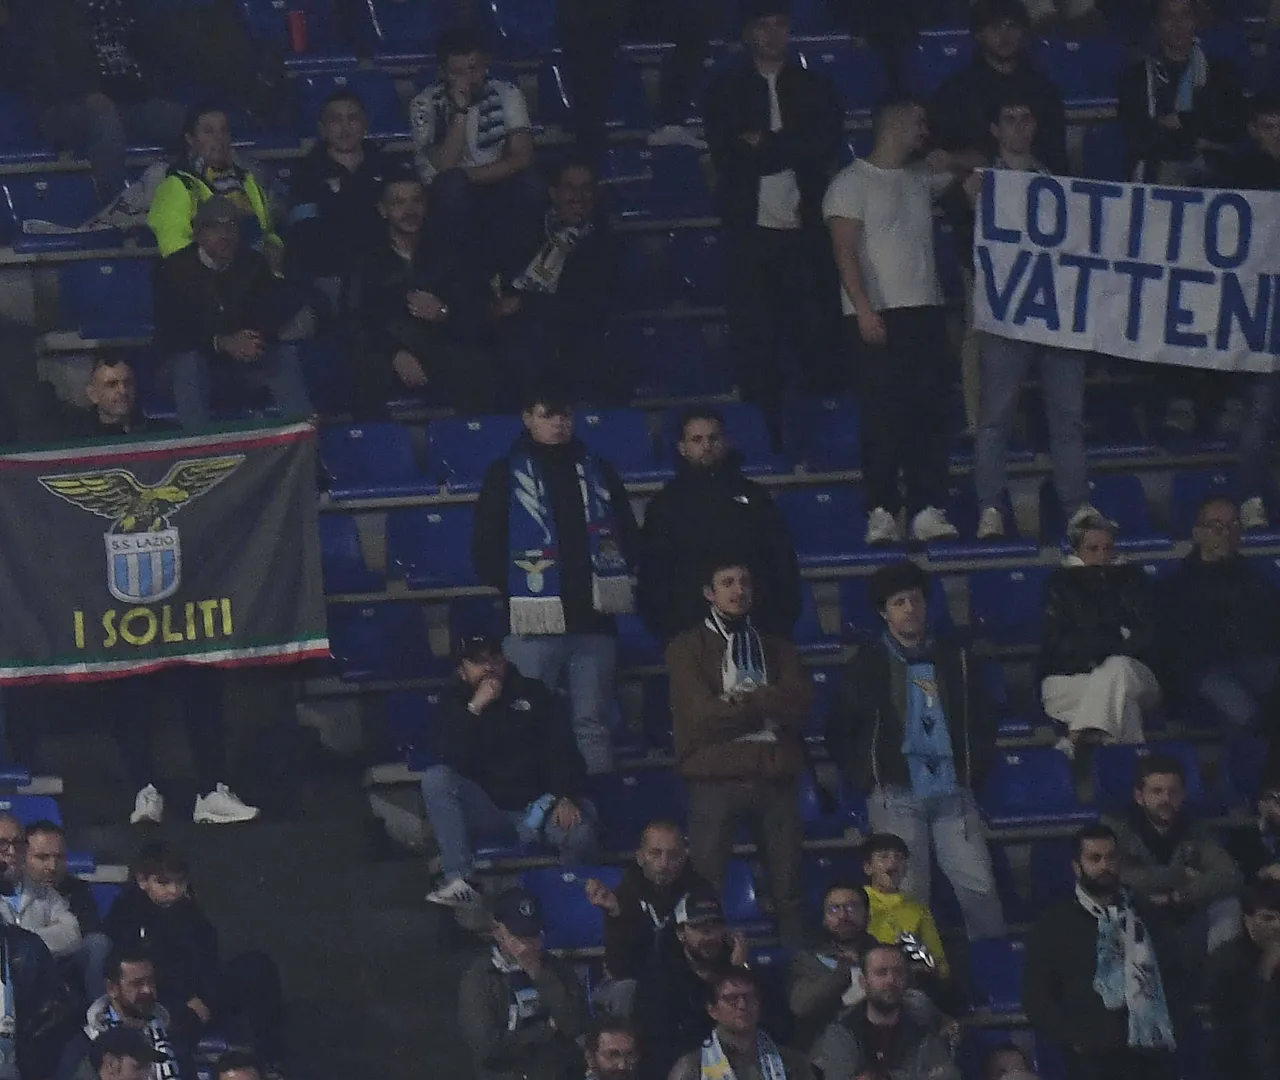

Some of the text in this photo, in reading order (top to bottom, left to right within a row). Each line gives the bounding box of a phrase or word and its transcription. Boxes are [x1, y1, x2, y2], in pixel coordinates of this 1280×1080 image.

[981, 170, 1252, 269] LOTITO
[978, 246, 1280, 354] VATTEN
[137, 535, 175, 549] LAZIO
[74, 598, 234, 648] I SOLITI
